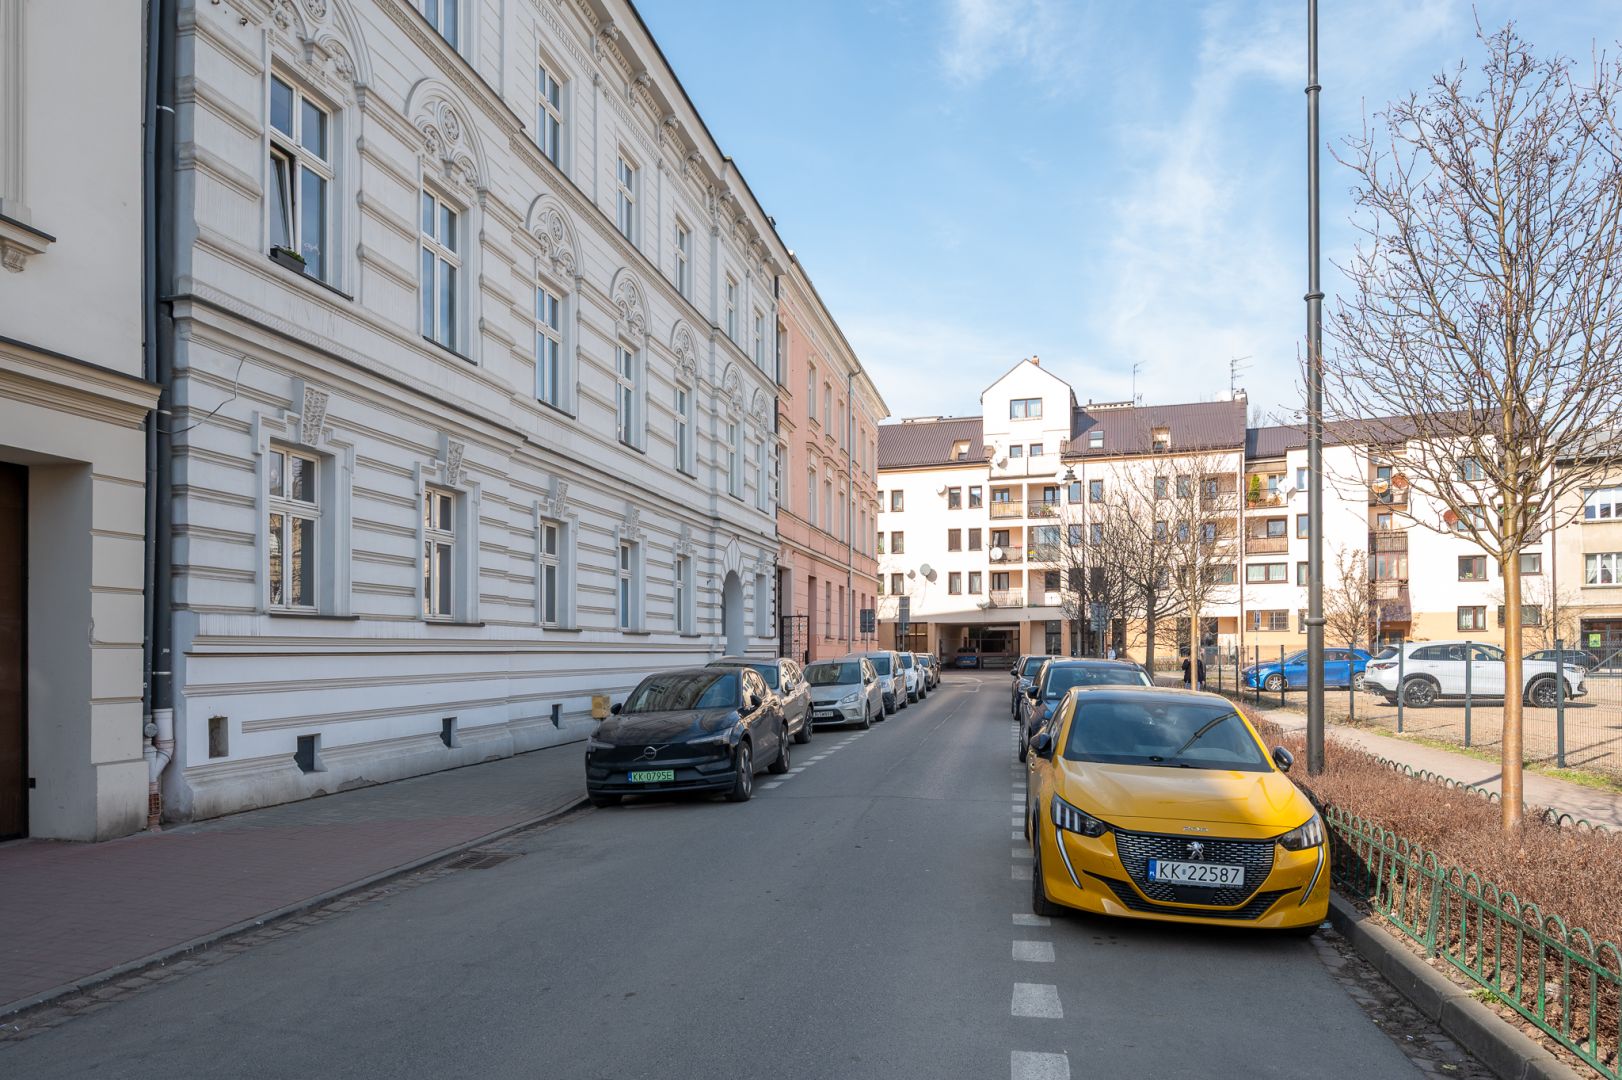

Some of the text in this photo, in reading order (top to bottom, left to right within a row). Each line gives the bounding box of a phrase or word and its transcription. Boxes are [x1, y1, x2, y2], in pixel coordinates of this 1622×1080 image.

[633, 771, 672, 781] KK 0795E
[1159, 862, 1240, 884] KK 22587
